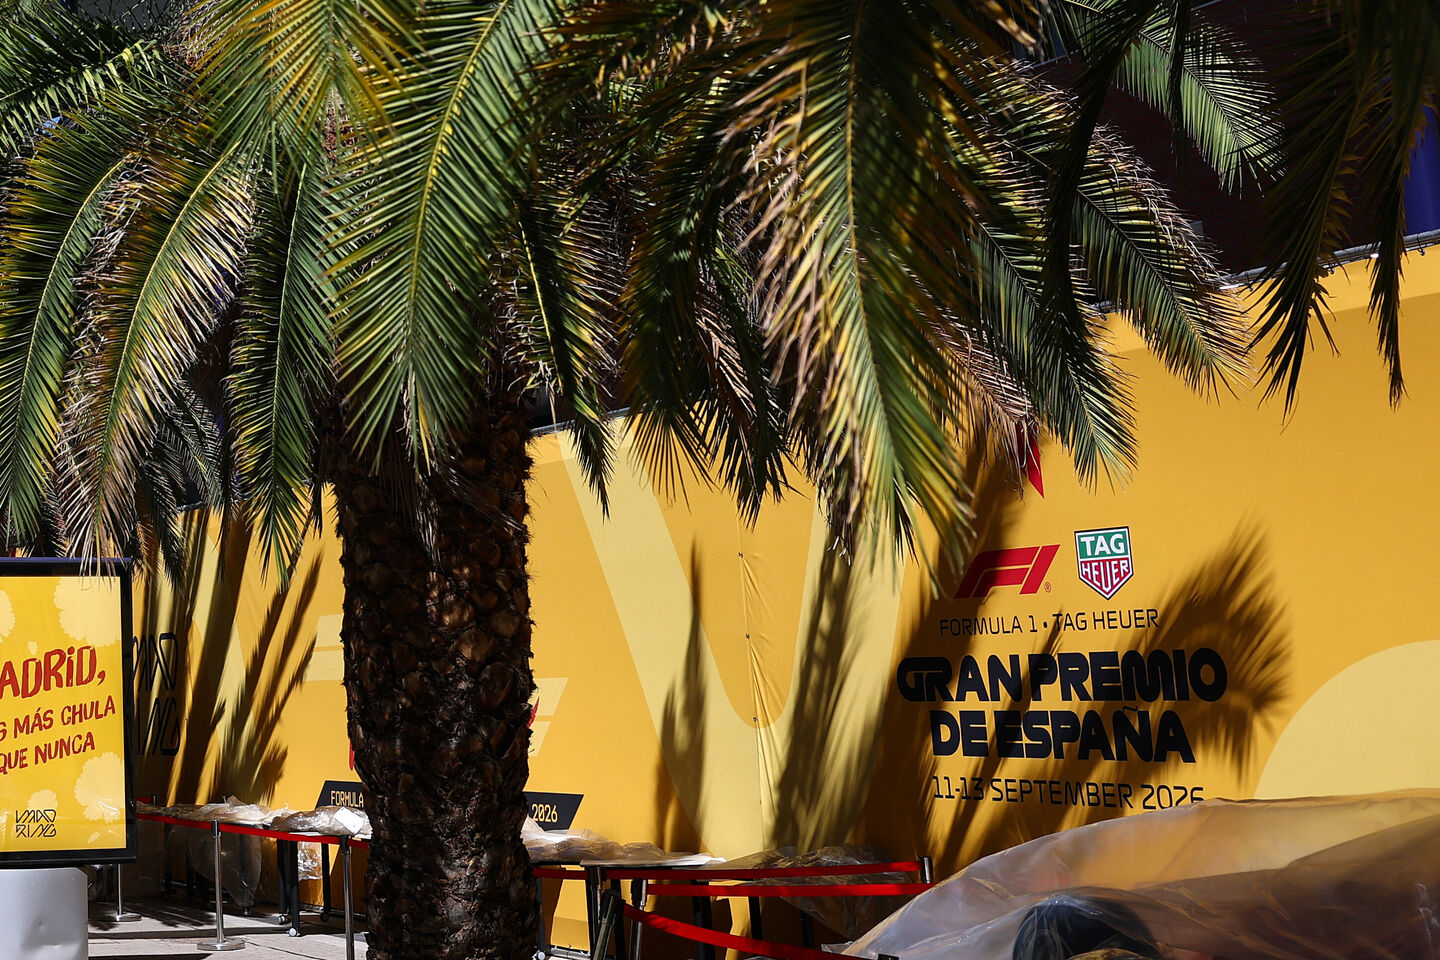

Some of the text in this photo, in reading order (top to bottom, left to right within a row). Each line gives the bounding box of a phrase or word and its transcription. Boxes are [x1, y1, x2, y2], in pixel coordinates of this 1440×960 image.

[1081, 533, 1126, 557] TAG
[1082, 559, 1129, 593] HEUER
[940, 608, 1160, 637] FORMULA 1 TAG HEUER
[897, 647, 1228, 703] GRAN PREMIO
[13, 707, 54, 739] MÁS
[61, 695, 116, 726] CHULA
[34, 732, 96, 766] NUNCA
[929, 706, 1197, 764] DE ESPAÑA
[331, 790, 364, 808] FORMULA
[932, 776, 985, 801] 11-13
[989, 778, 1134, 809] SEPTEMBER
[530, 803, 558, 823] 2026
